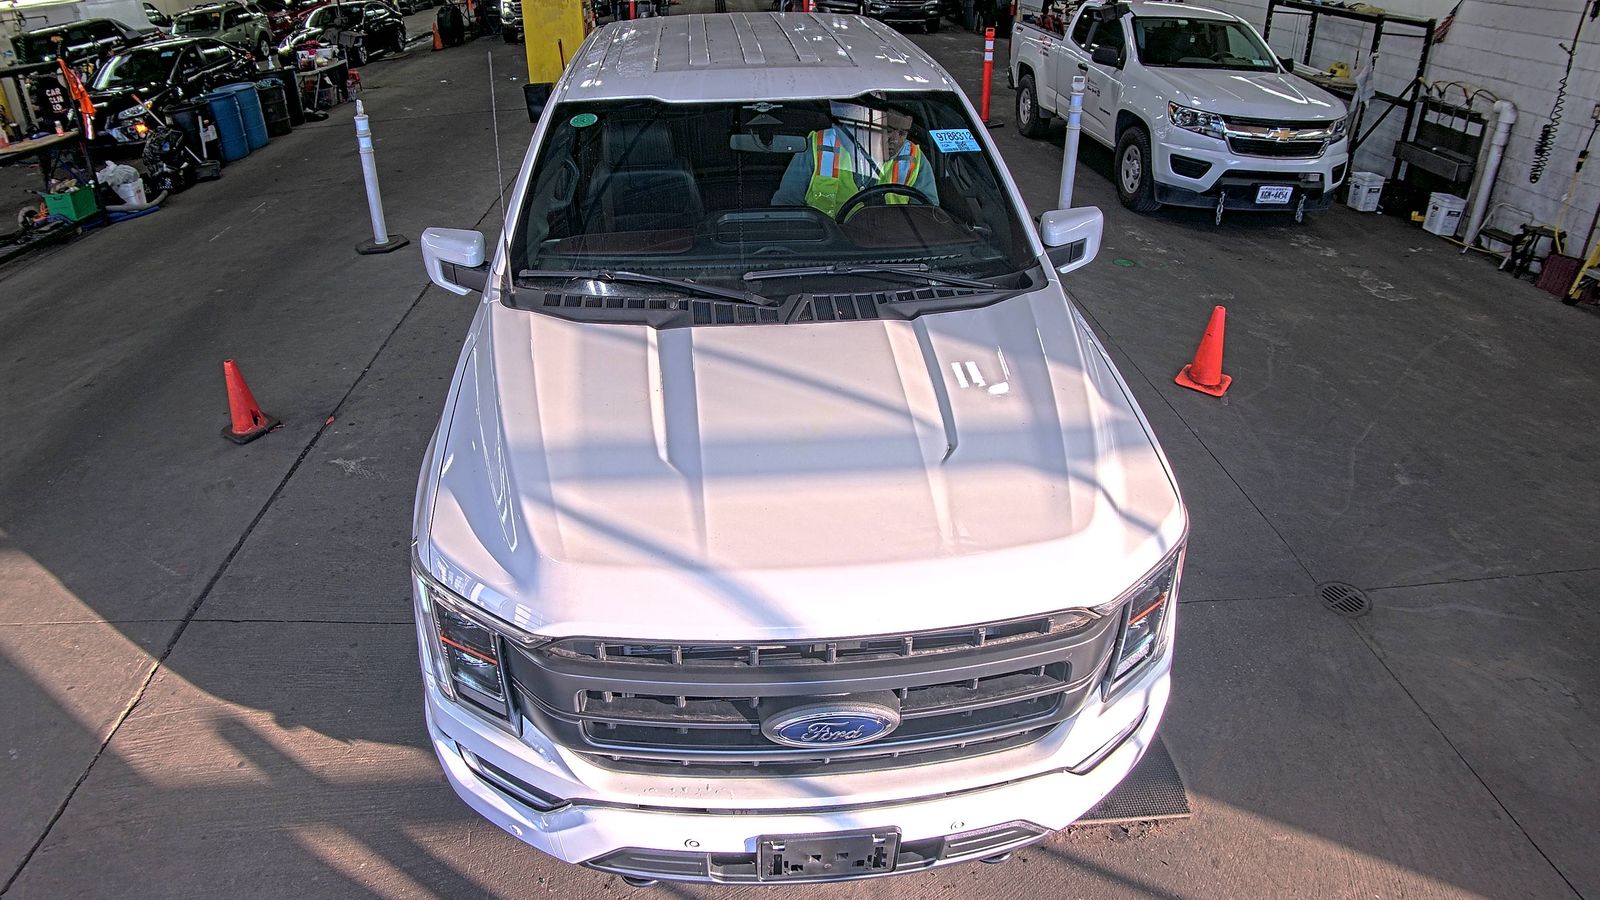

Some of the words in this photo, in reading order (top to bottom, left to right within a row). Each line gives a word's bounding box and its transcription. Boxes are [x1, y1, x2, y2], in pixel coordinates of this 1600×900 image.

[45, 87, 62, 97] CAR
[935, 131, 974, 142] 9788312
[800, 721, 865, 742] Ford
